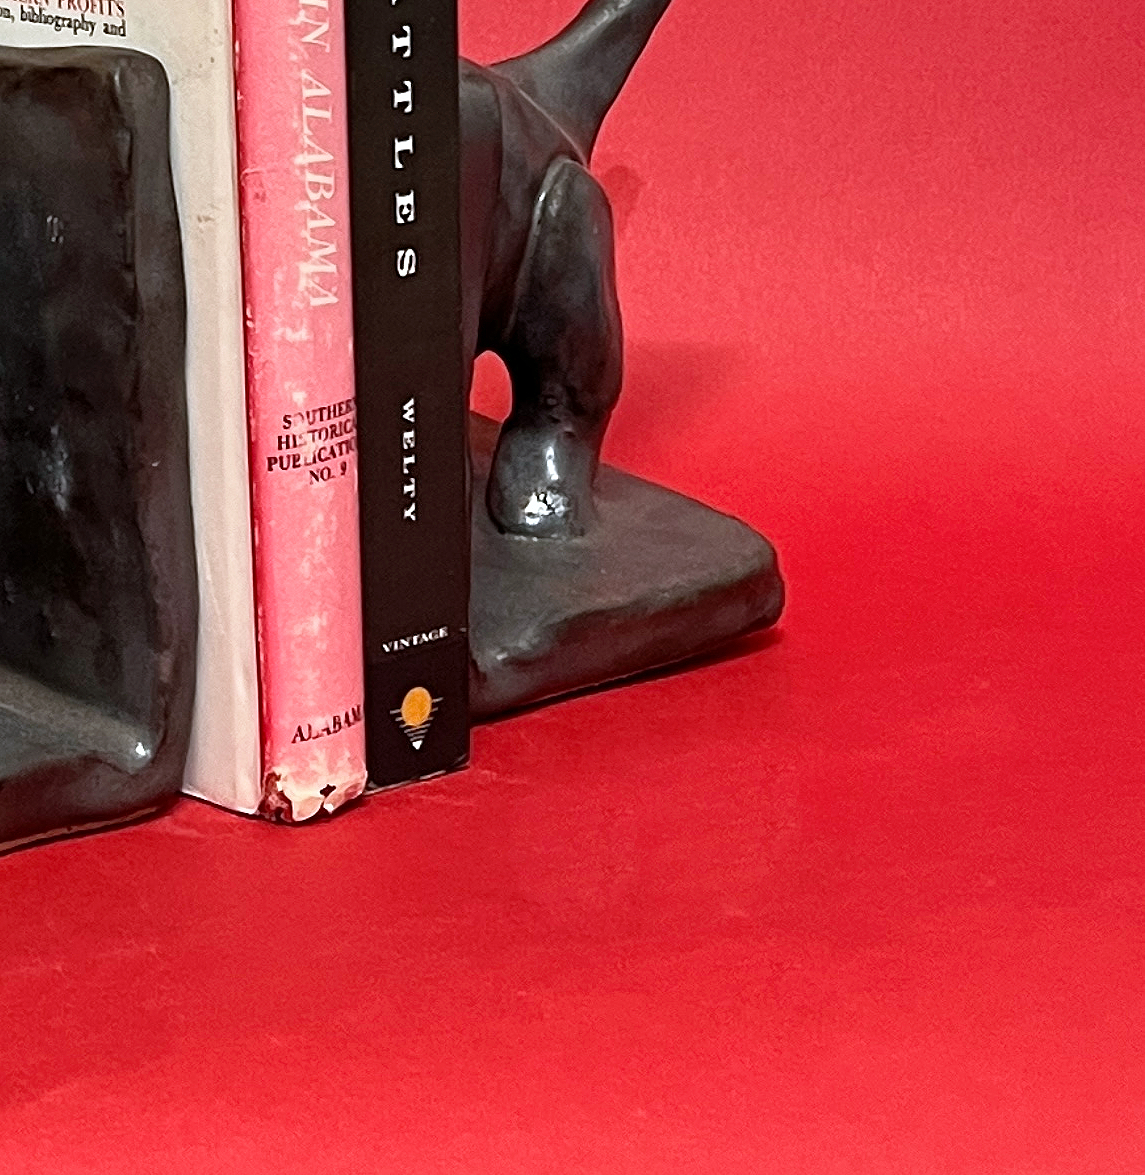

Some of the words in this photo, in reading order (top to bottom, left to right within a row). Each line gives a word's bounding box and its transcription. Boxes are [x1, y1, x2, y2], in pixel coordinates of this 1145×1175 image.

[20, 7, 97, 36] bibliography
[103, 20, 126, 37] and
[299, 69, 339, 307] ALABAMA
[340, 462, 346, 475] 9
[403, 398, 415, 521] WELTY
[382, 626, 448, 653] VINTAGE
[292, 704, 362, 744] ALABAM
